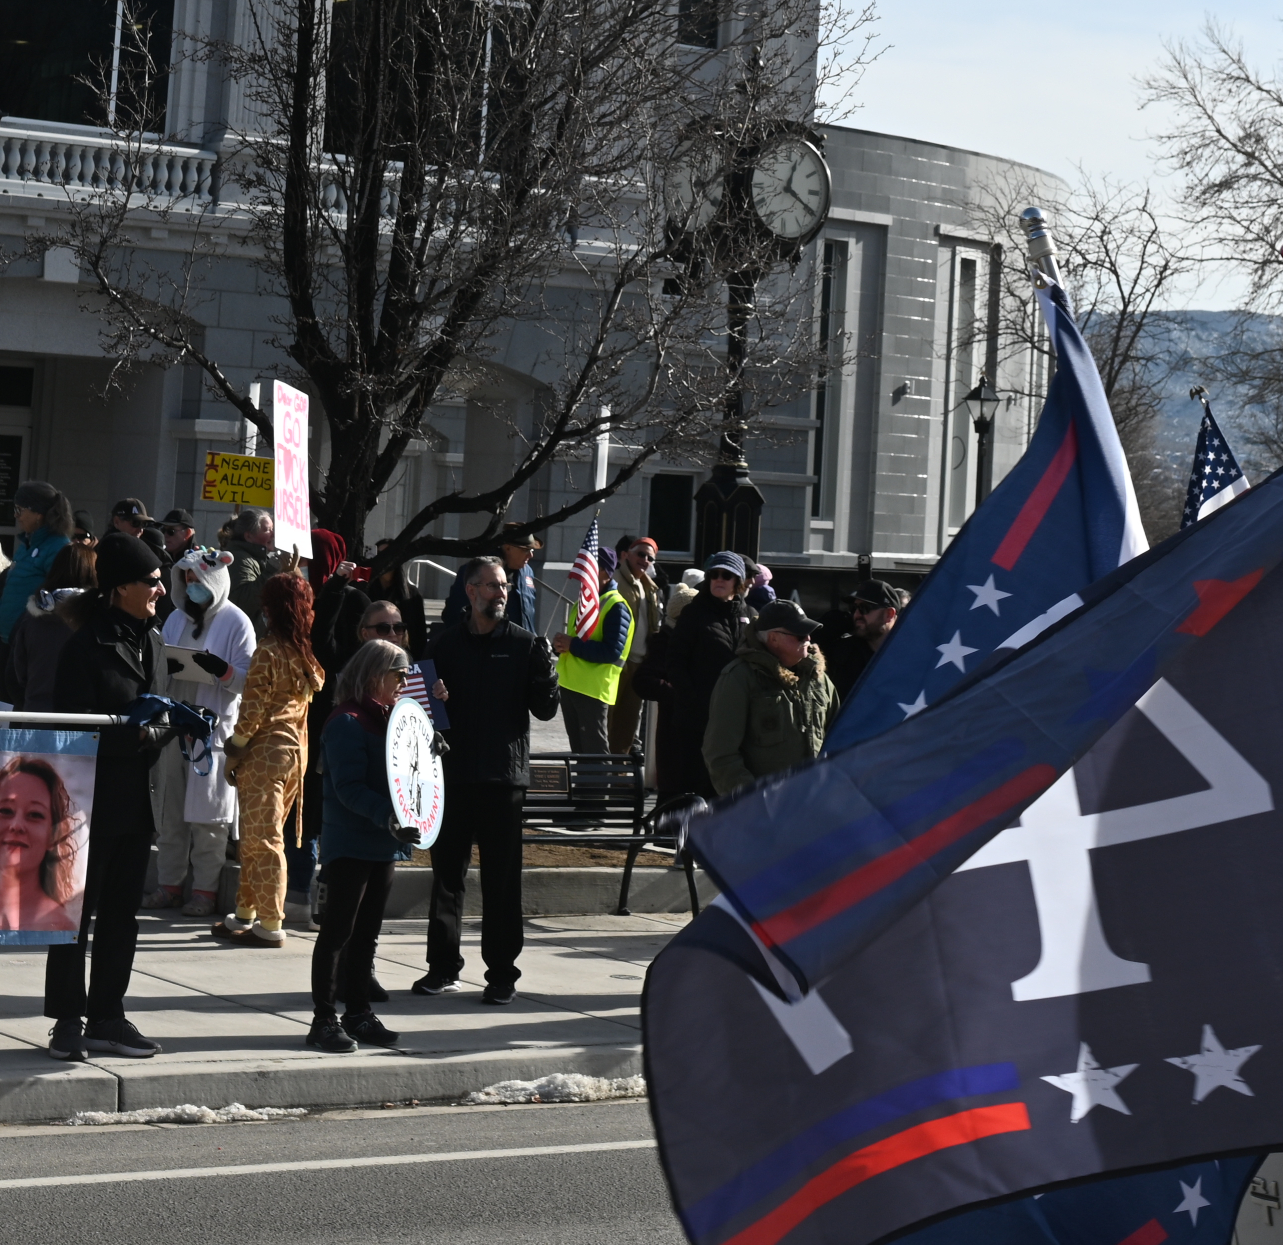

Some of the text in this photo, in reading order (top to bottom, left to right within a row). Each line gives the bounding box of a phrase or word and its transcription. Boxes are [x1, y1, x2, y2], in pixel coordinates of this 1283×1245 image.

[283, 410, 301, 448] GO
[395, 715, 407, 737] OUR
[394, 777, 439, 835] FIGHT TYRANNY!
